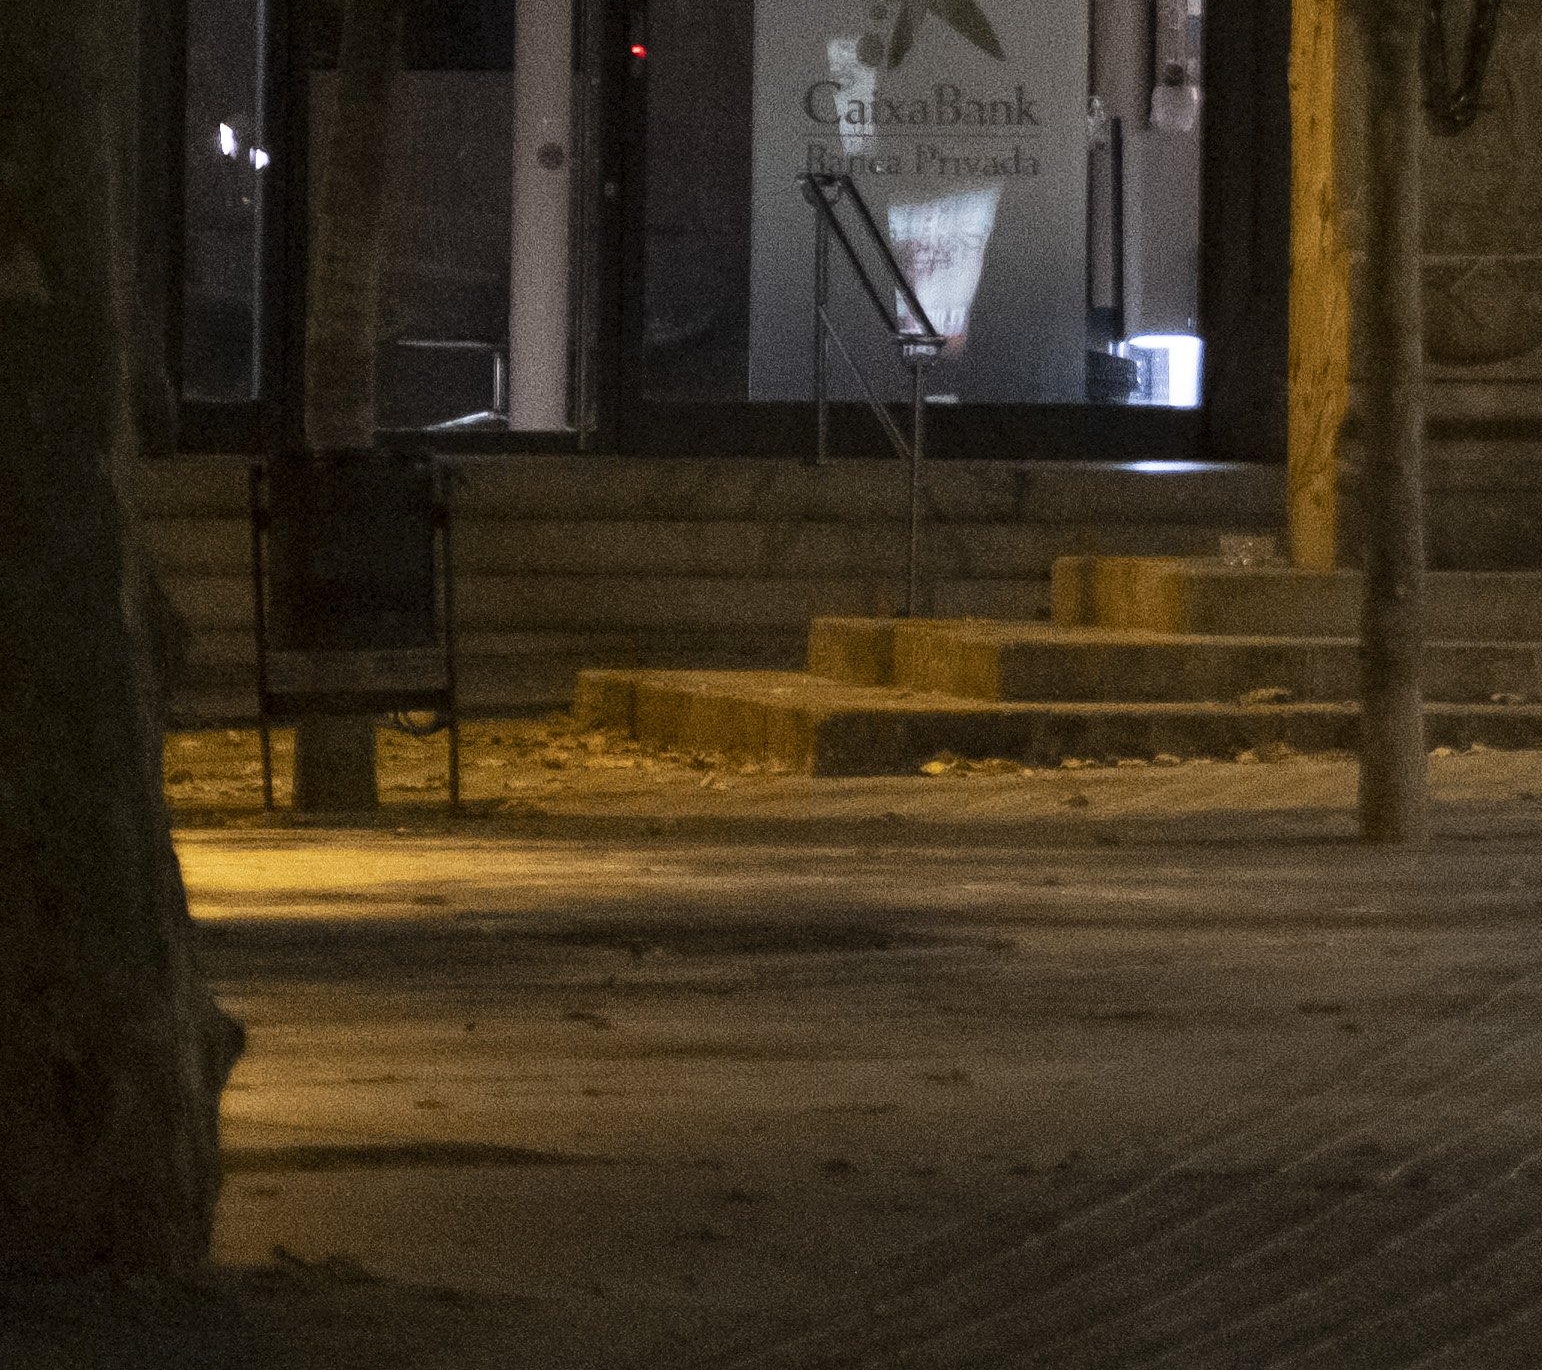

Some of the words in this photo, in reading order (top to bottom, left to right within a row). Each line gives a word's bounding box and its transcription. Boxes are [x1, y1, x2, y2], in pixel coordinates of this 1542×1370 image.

[804, 80, 1040, 127] CaixaBank
[806, 144, 898, 176] Banca
[916, 143, 1041, 176] Privada
